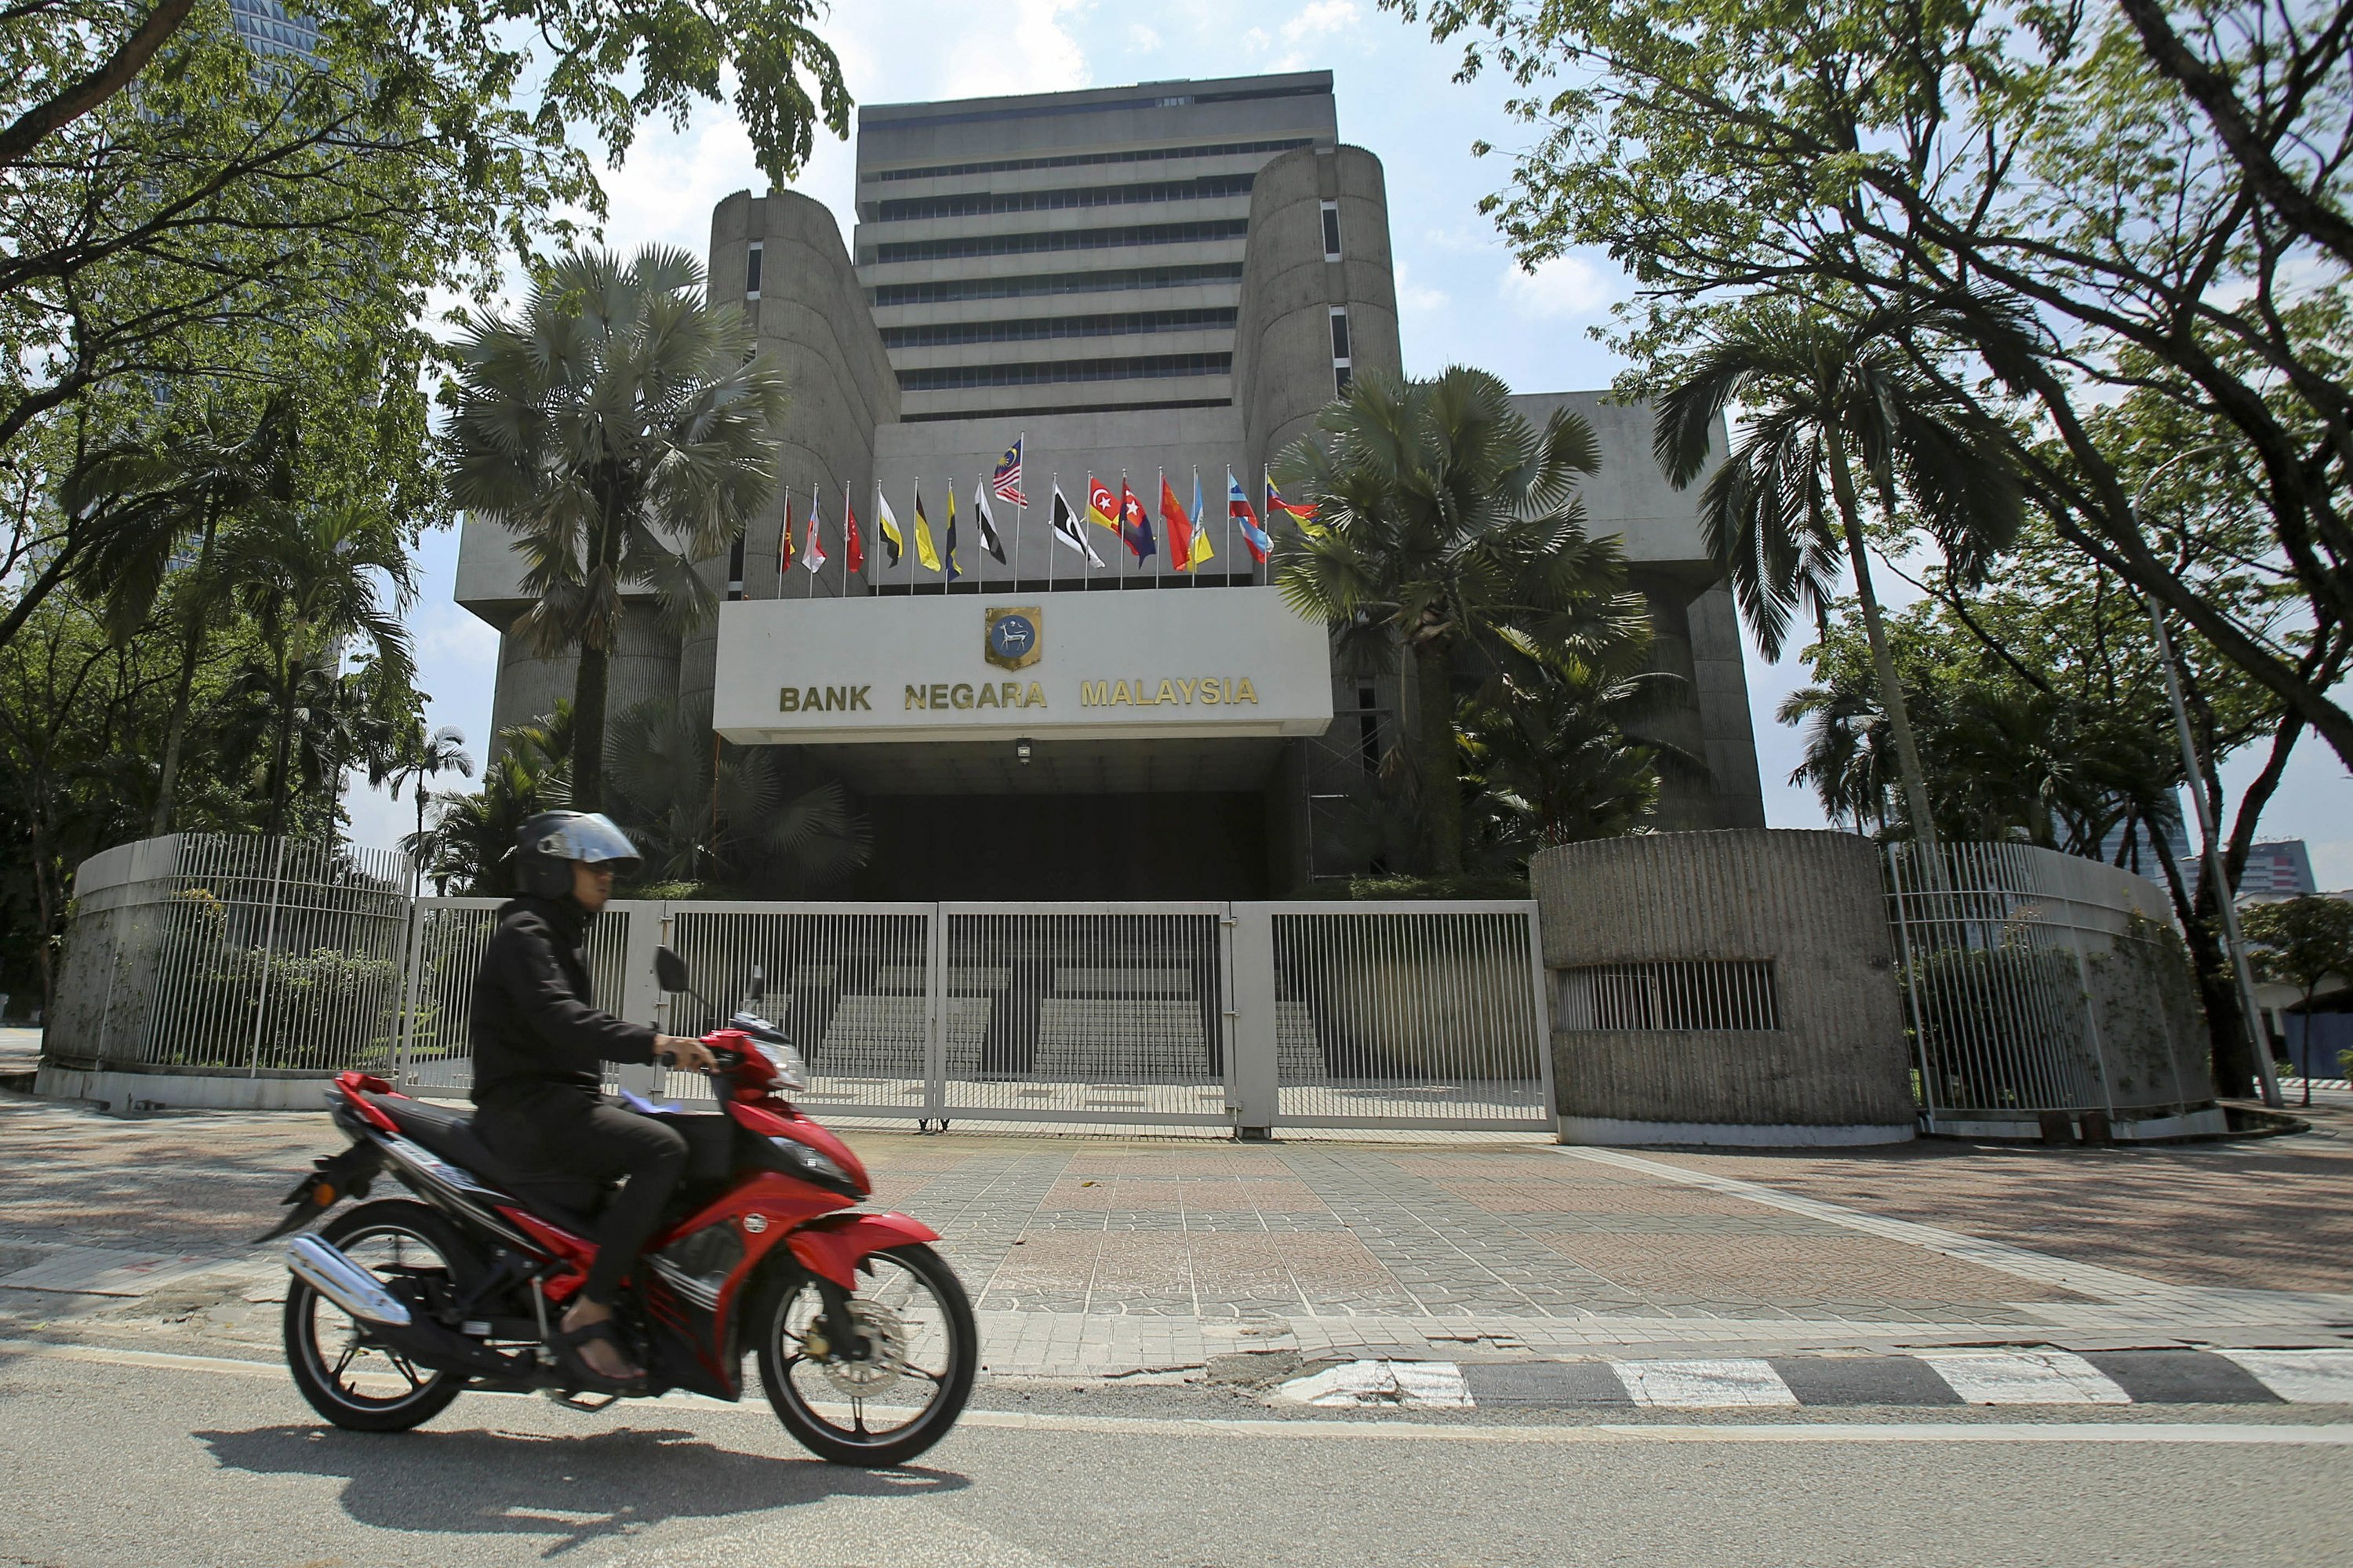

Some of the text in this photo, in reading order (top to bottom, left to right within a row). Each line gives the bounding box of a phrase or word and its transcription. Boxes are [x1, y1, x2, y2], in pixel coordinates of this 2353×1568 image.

[780, 677, 1258, 712] BANK NEGARA MALAYSIA
